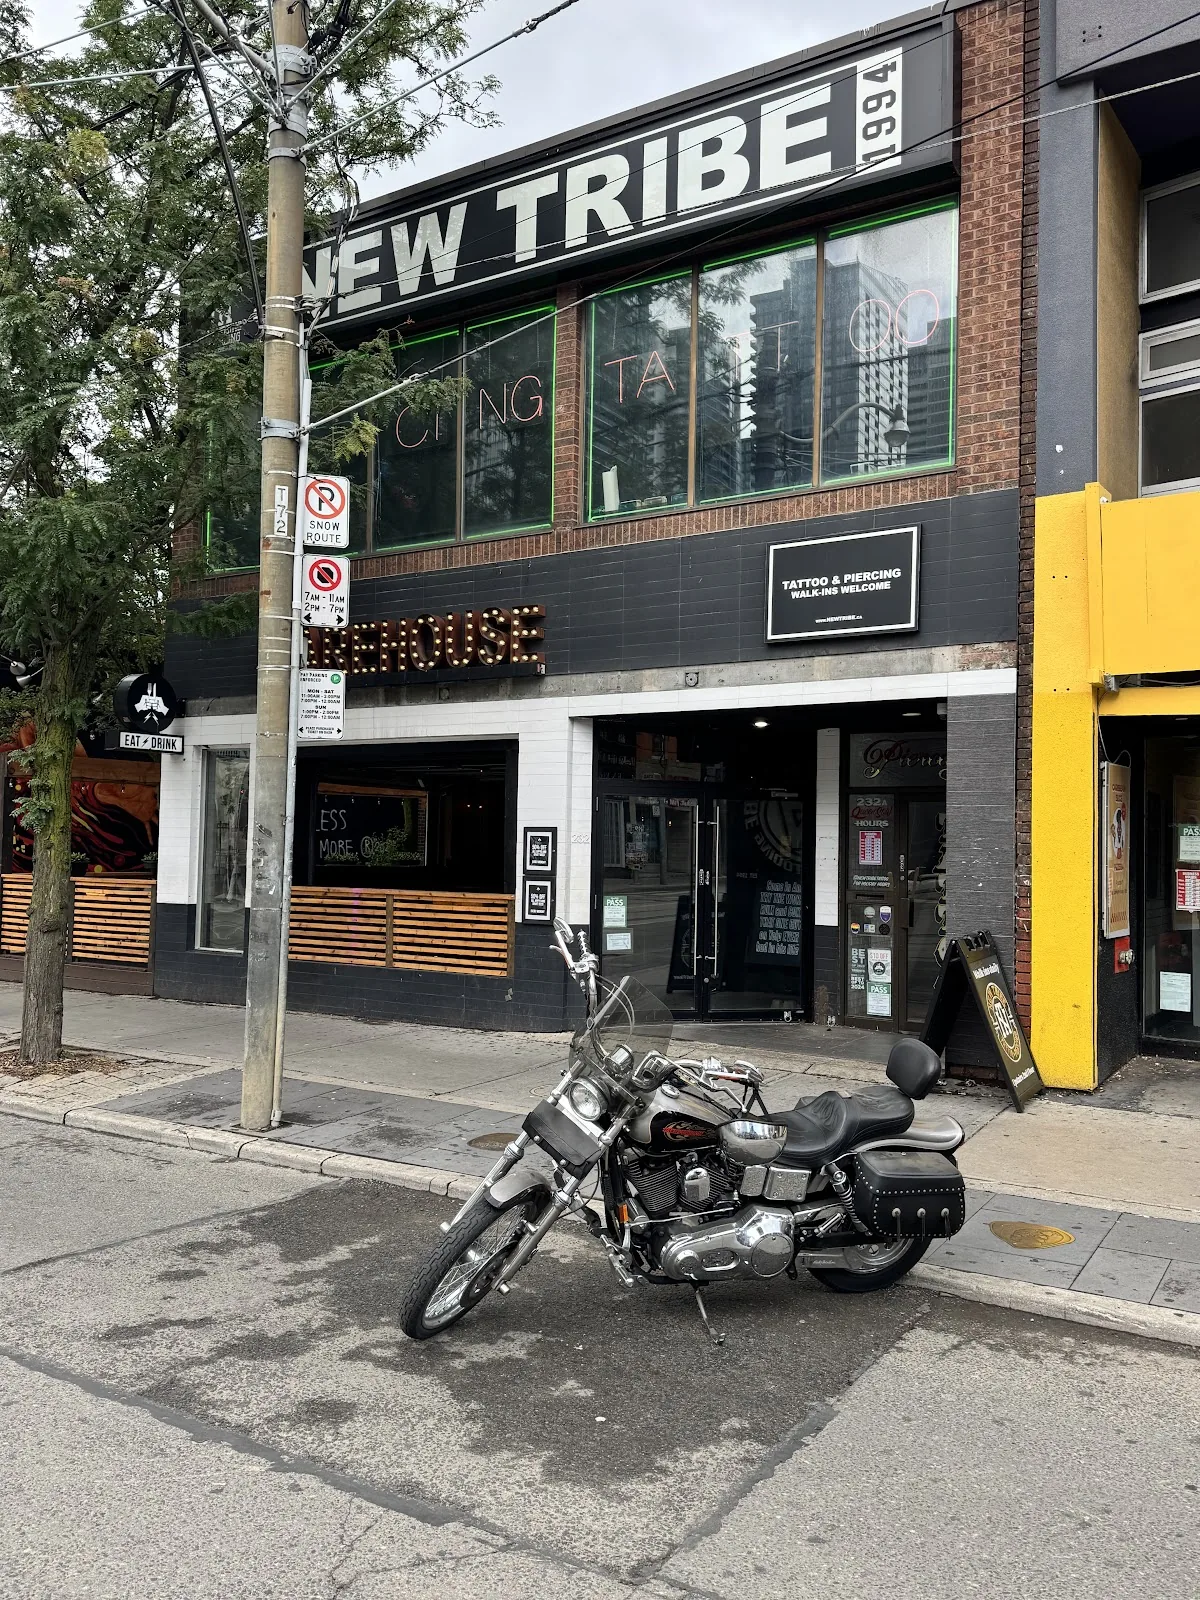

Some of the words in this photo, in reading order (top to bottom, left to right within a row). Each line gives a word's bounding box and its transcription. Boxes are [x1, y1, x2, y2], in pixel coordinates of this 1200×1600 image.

[861, 61, 897, 162] 1994
[302, 202, 467, 319] NEW
[496, 85, 833, 264] TRIBE
[309, 520, 340, 531] SNOW
[306, 532, 341, 543] ROUTE
[781, 576, 829, 590] TATTOO
[831, 575, 841, 585] &
[844, 568, 901, 584] PIERCING
[791, 586, 838, 599] WALK-INS
[840, 580, 891, 594] WELCOME
[304, 591, 320, 602] 7AM
[329, 593, 345, 603] 11AM
[304, 602, 320, 612] 2PM
[329, 604, 344, 613] 7PM
[302, 604, 546, 673] REHOUSE
[125, 734, 140, 747] EAT
[151, 737, 177, 750] DRINK
[316, 809, 347, 831] ESS
[853, 819, 889, 829] HOURS
[1183, 828, 1200, 836] PAS
[870, 986, 888, 994] PASS
